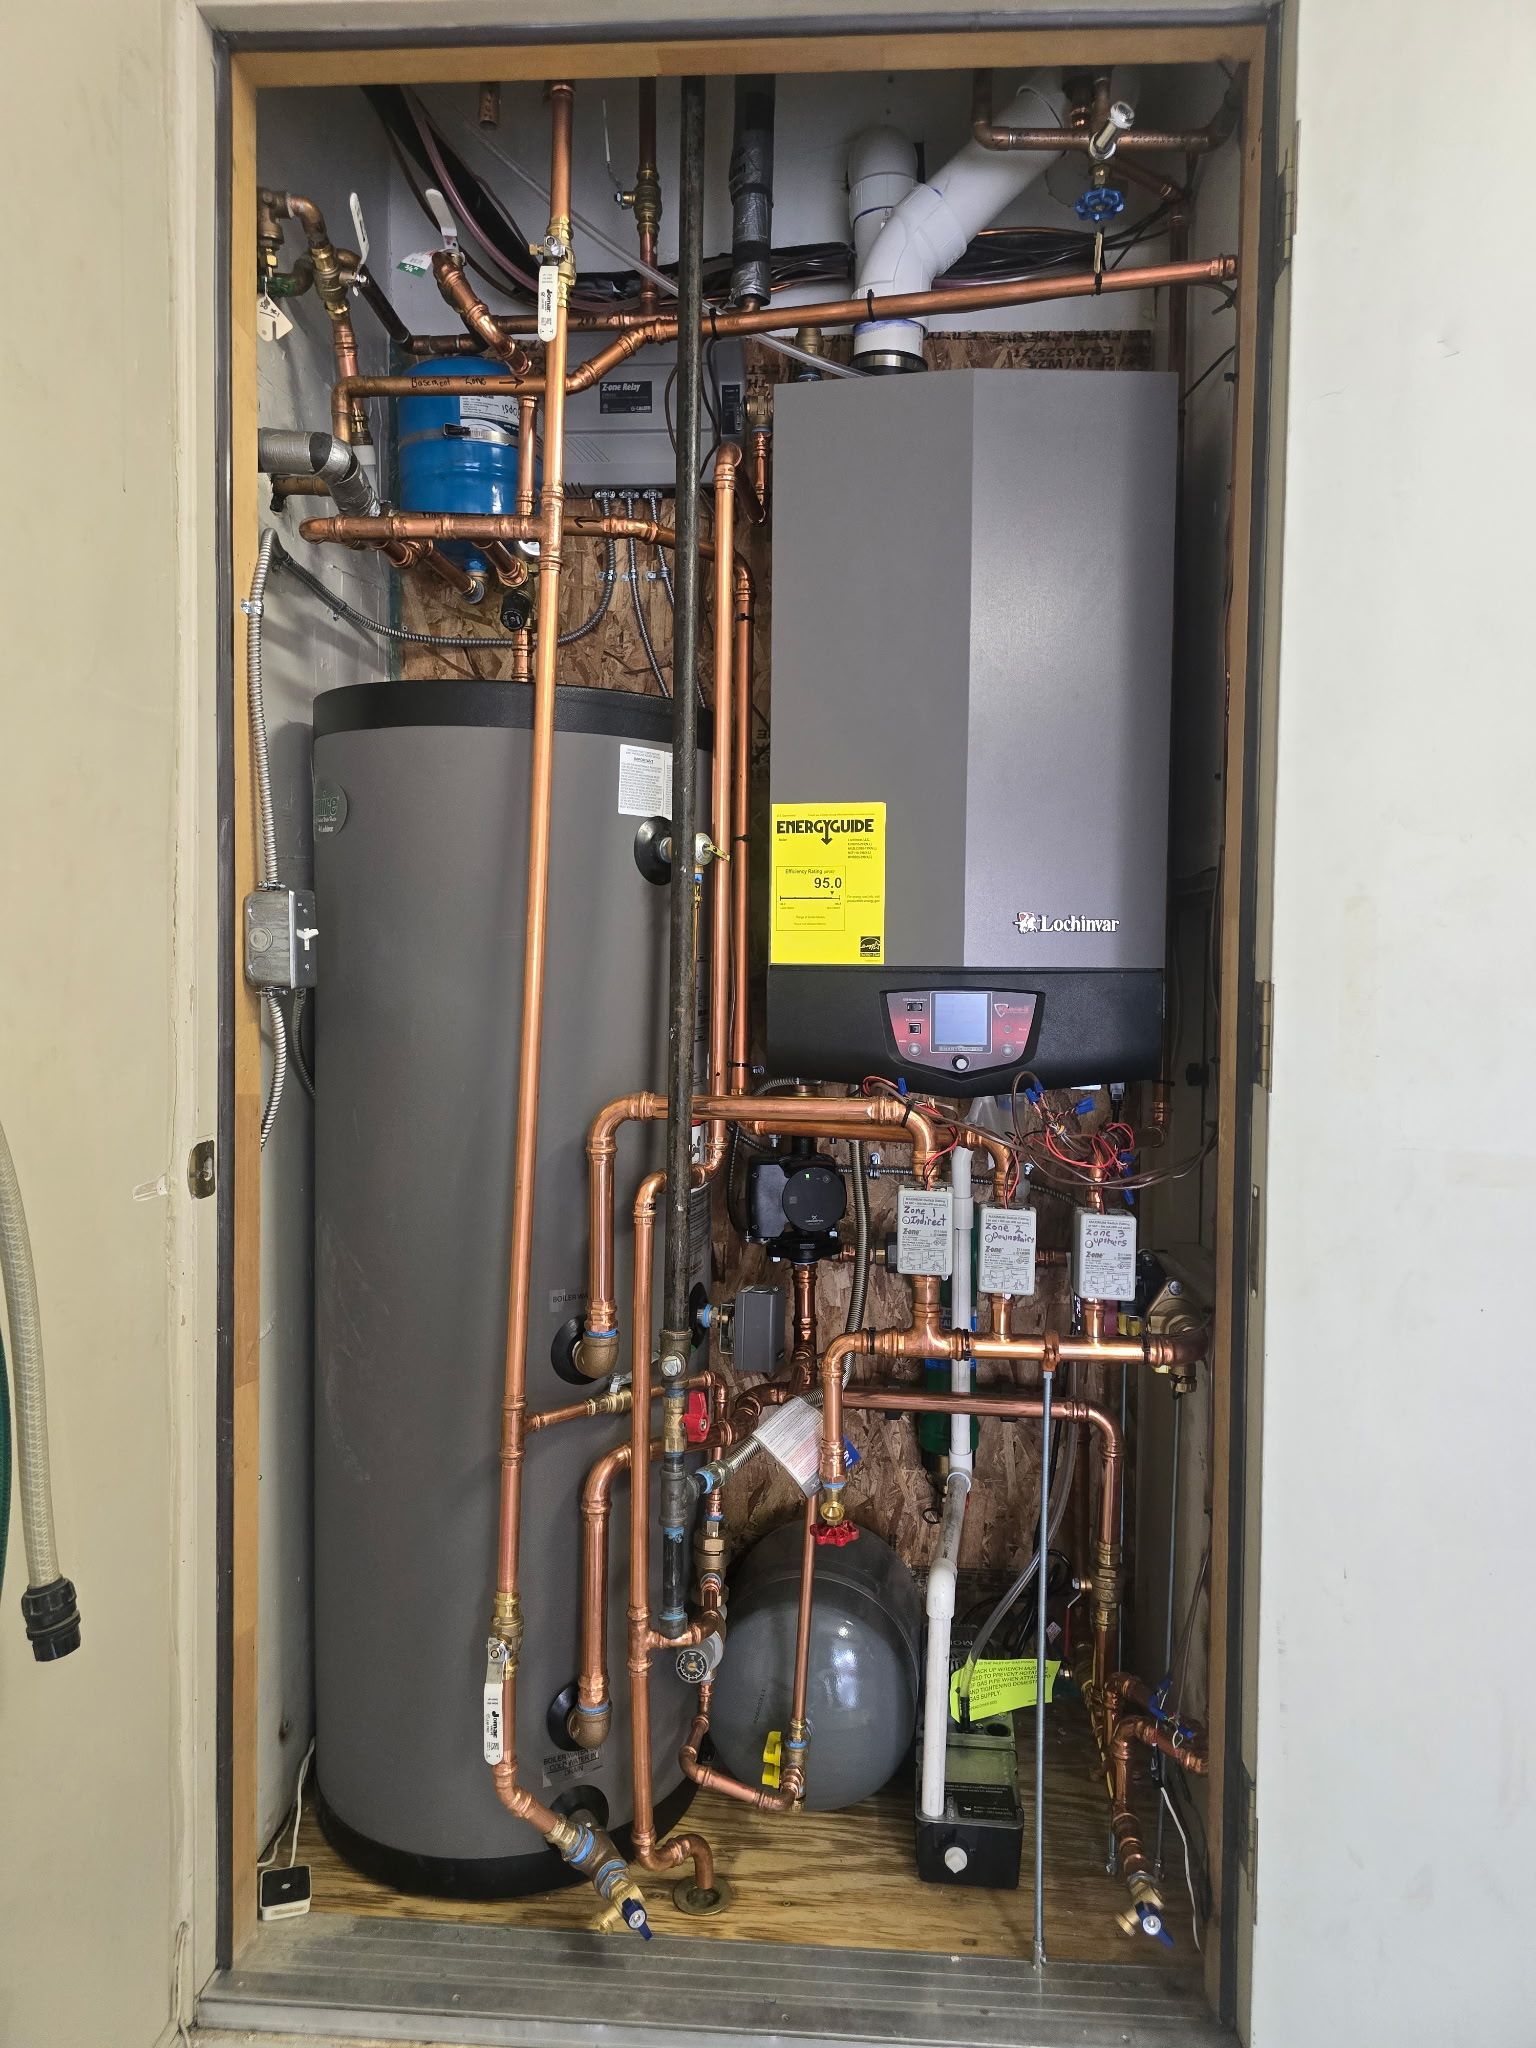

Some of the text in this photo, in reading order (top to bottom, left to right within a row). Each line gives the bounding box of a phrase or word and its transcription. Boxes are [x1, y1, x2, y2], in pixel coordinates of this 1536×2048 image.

[411, 377, 451, 389] Basement
[602, 383, 641, 393] Z-one Relay
[777, 818, 874, 835] ENERGYGUIDE
[814, 877, 842, 889] 95.0
[1039, 914, 1120, 932] Lochinvar
[904, 1206, 936, 1217] Zone 1
[910, 1214, 947, 1226] Indirect
[985, 1223, 1024, 1234] Zone 2
[1086, 1229, 1125, 1239] Zone 3
[552, 1295, 577, 1303] BOILER
[980, 1682, 1011, 1694] TIGHTENING
[492, 1710, 500, 1739] Jomar
